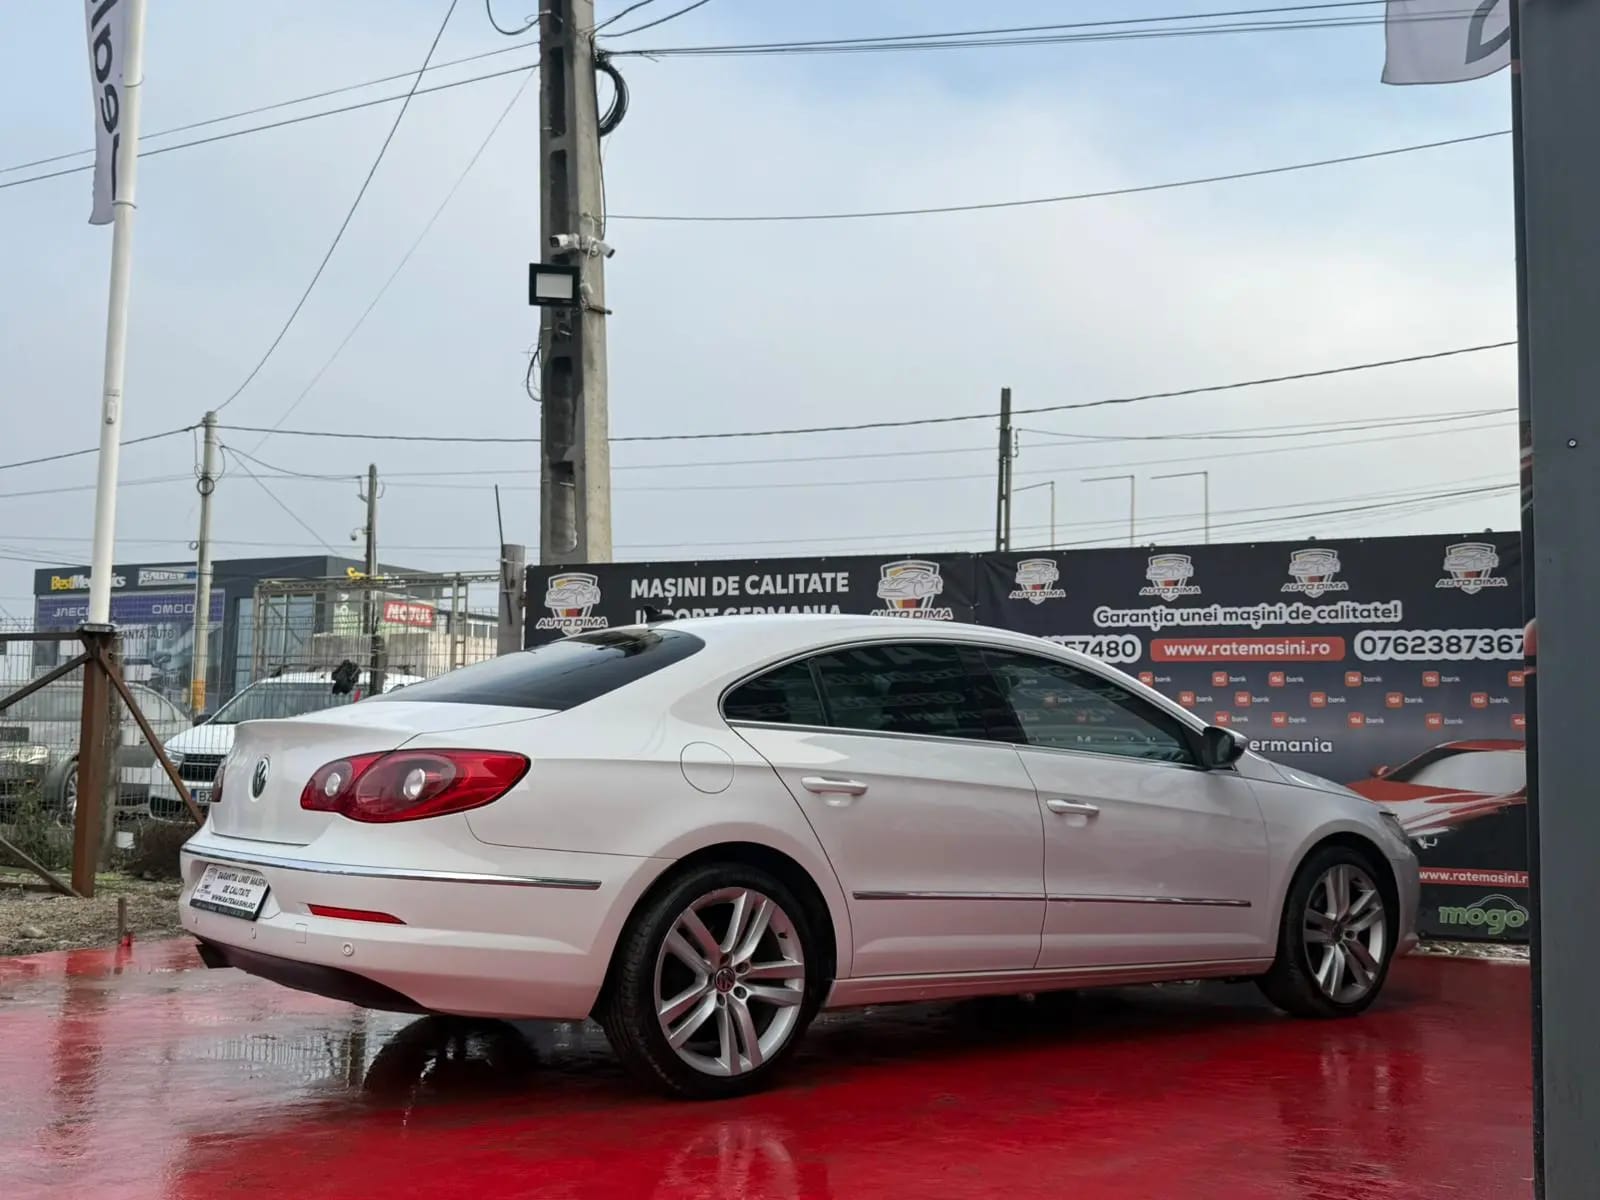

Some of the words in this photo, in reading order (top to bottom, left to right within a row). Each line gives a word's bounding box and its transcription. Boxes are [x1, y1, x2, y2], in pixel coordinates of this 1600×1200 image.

[630, 577, 706, 606] MAȘINI
[711, 576, 740, 597] DE
[744, 572, 849, 596] CALITATE
[1283, 583, 1315, 591] AUTO
[1317, 582, 1348, 590] DIMA
[1438, 579, 1472, 587] AUTO
[1473, 578, 1506, 586] DIMA
[1039, 590, 1065, 598] DIMA
[1171, 586, 1201, 594] DIMA
[871, 609, 911, 618] AUTO
[913, 608, 951, 619] DIMA
[1097, 608, 1175, 628] Garanția
[1180, 608, 1218, 622] unei
[1223, 605, 1283, 625] mașini
[1288, 605, 1312, 620] de
[1317, 603, 1399, 620] calitate!
[537, 618, 573, 628] AUTO
[574, 616, 607, 627] DIMA
[1163, 640, 1331, 657] www.ratemasini.ro
[1360, 634, 1524, 655] 0762387367
[1249, 737, 1333, 753] ermania
[1438, 906, 1526, 935] mogo
